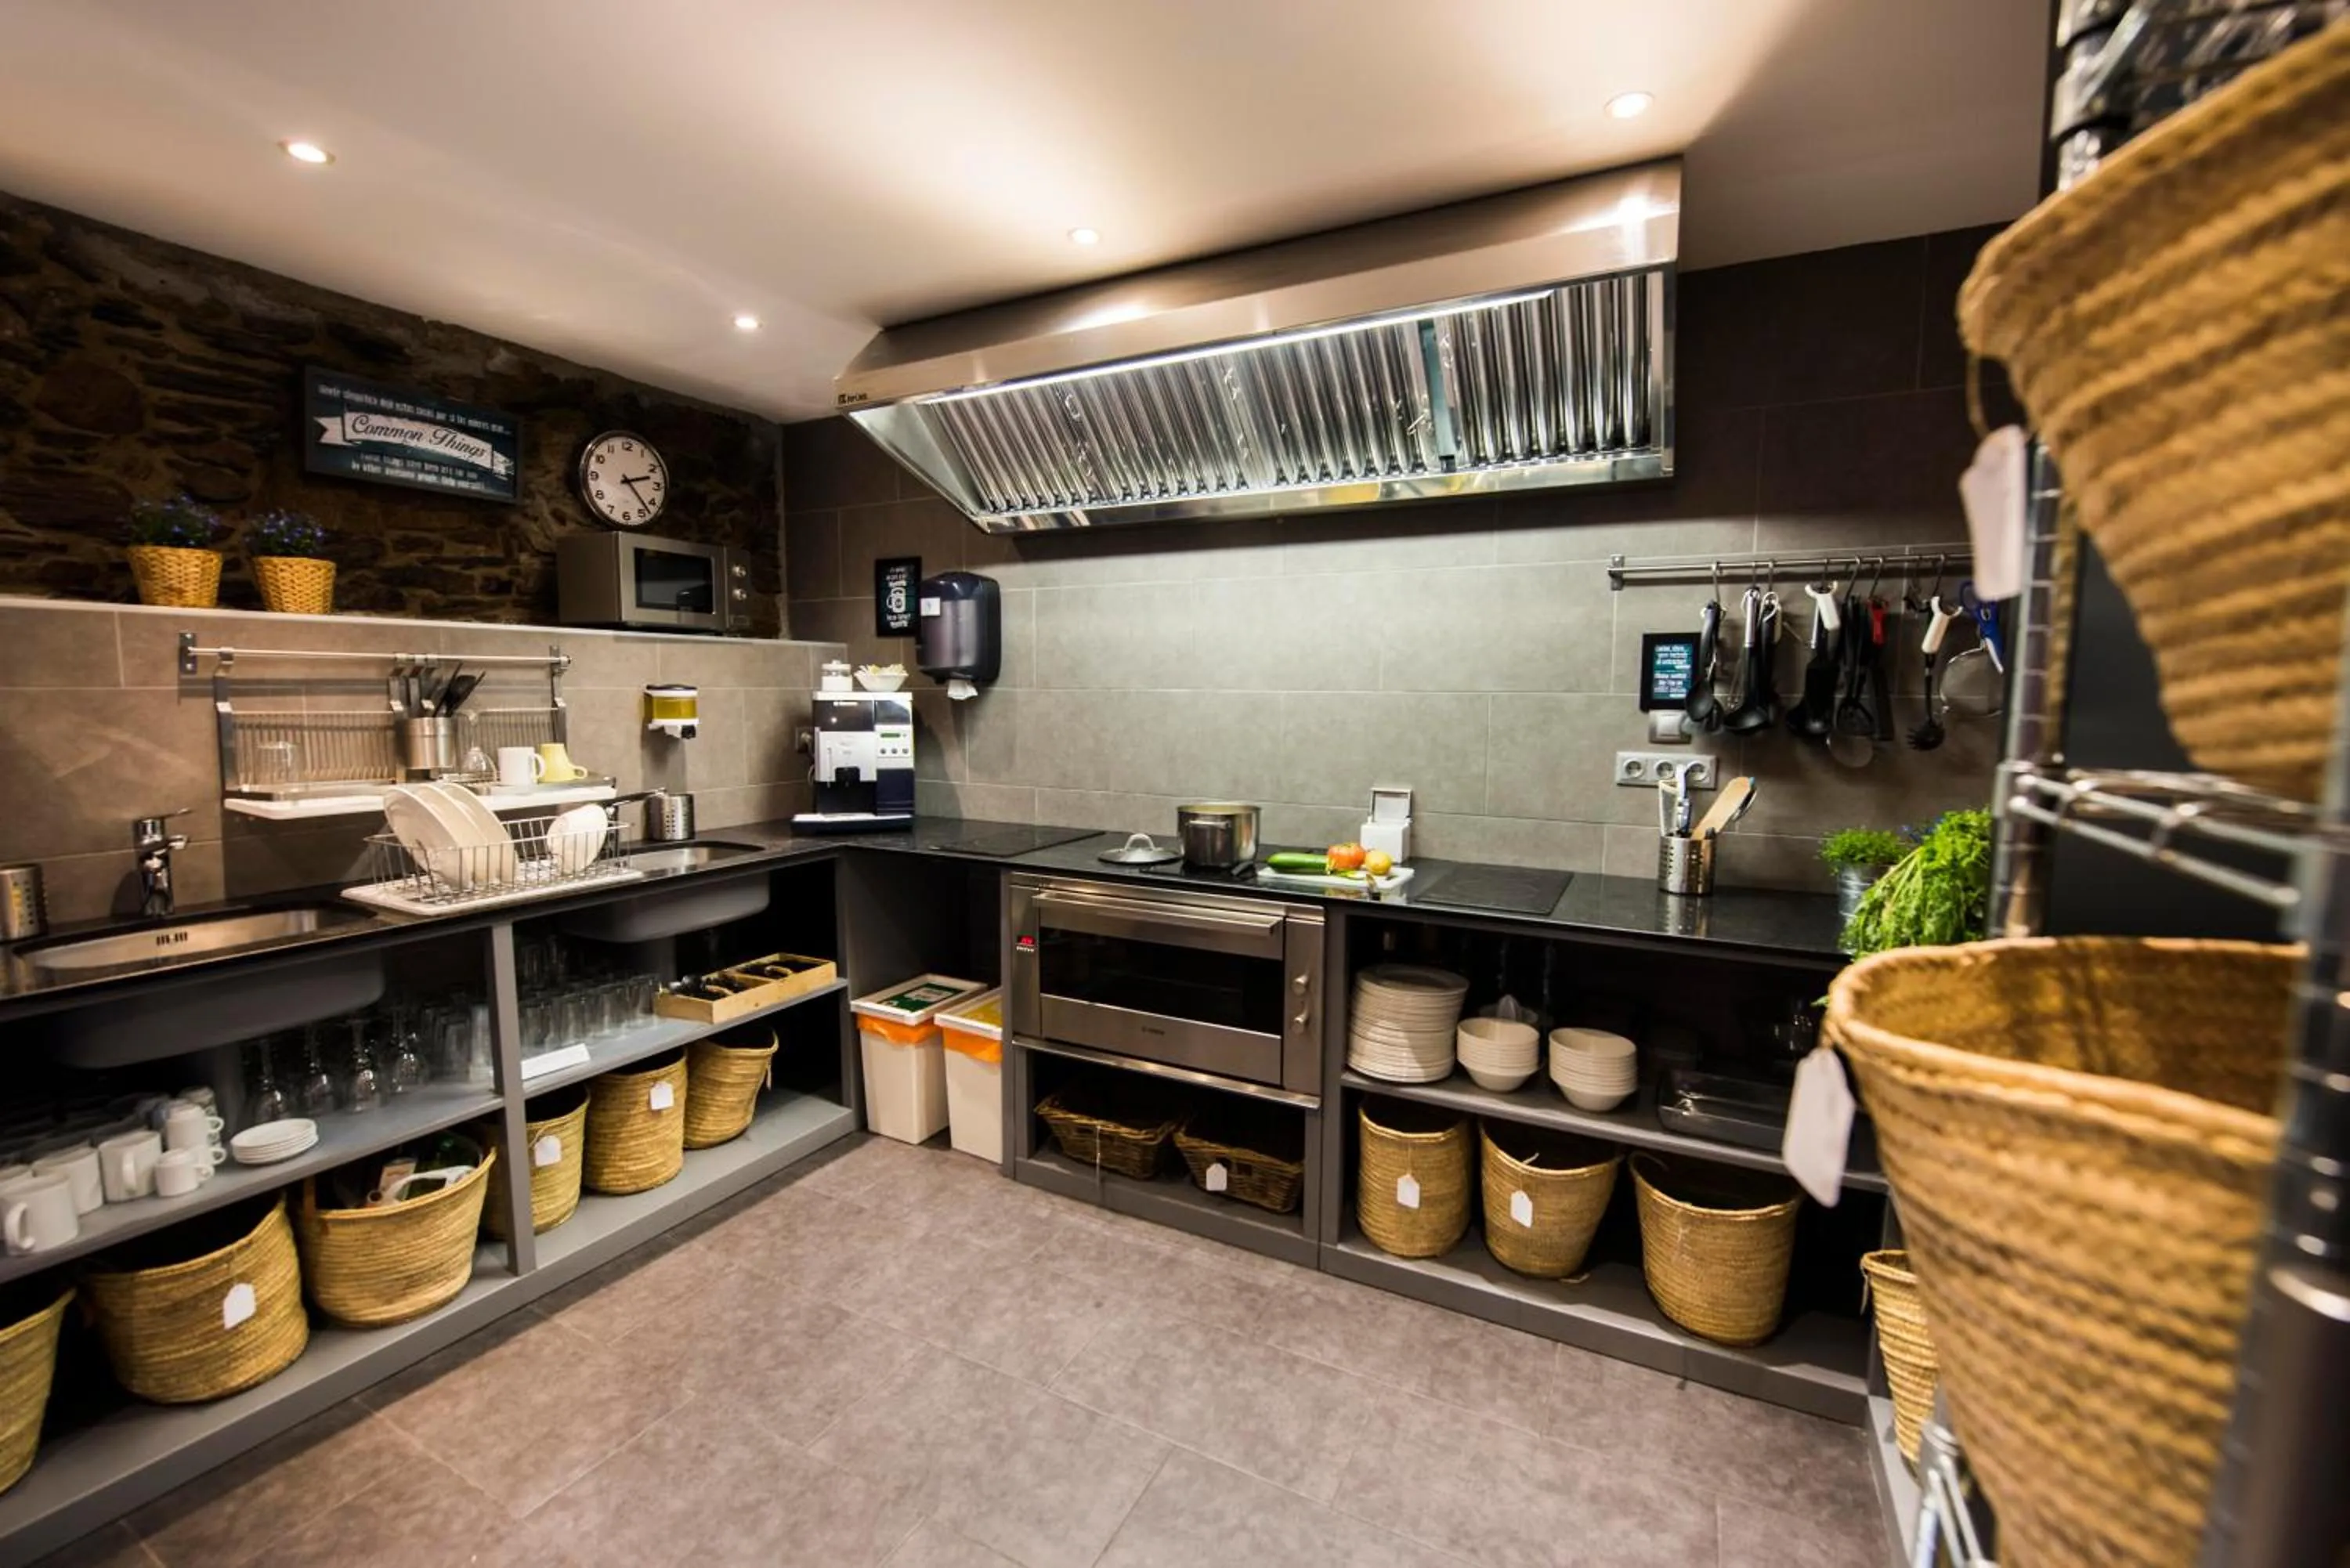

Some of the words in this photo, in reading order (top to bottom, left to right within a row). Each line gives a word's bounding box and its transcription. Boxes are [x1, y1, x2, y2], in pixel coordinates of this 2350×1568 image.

[351, 414, 424, 442] Common
[429, 428, 486, 458] Things
[607, 444, 615, 453] 11
[622, 441, 633, 452] 12
[595, 453, 606, 464] 10
[649, 463, 656, 473] 2
[590, 471, 599, 482] 9
[652, 482, 660, 491] 3
[595, 490, 605, 500] 8
[648, 497, 656, 506] 4
[607, 504, 615, 514] 7
[637, 508, 646, 518] 5
[622, 511, 631, 521] 6
